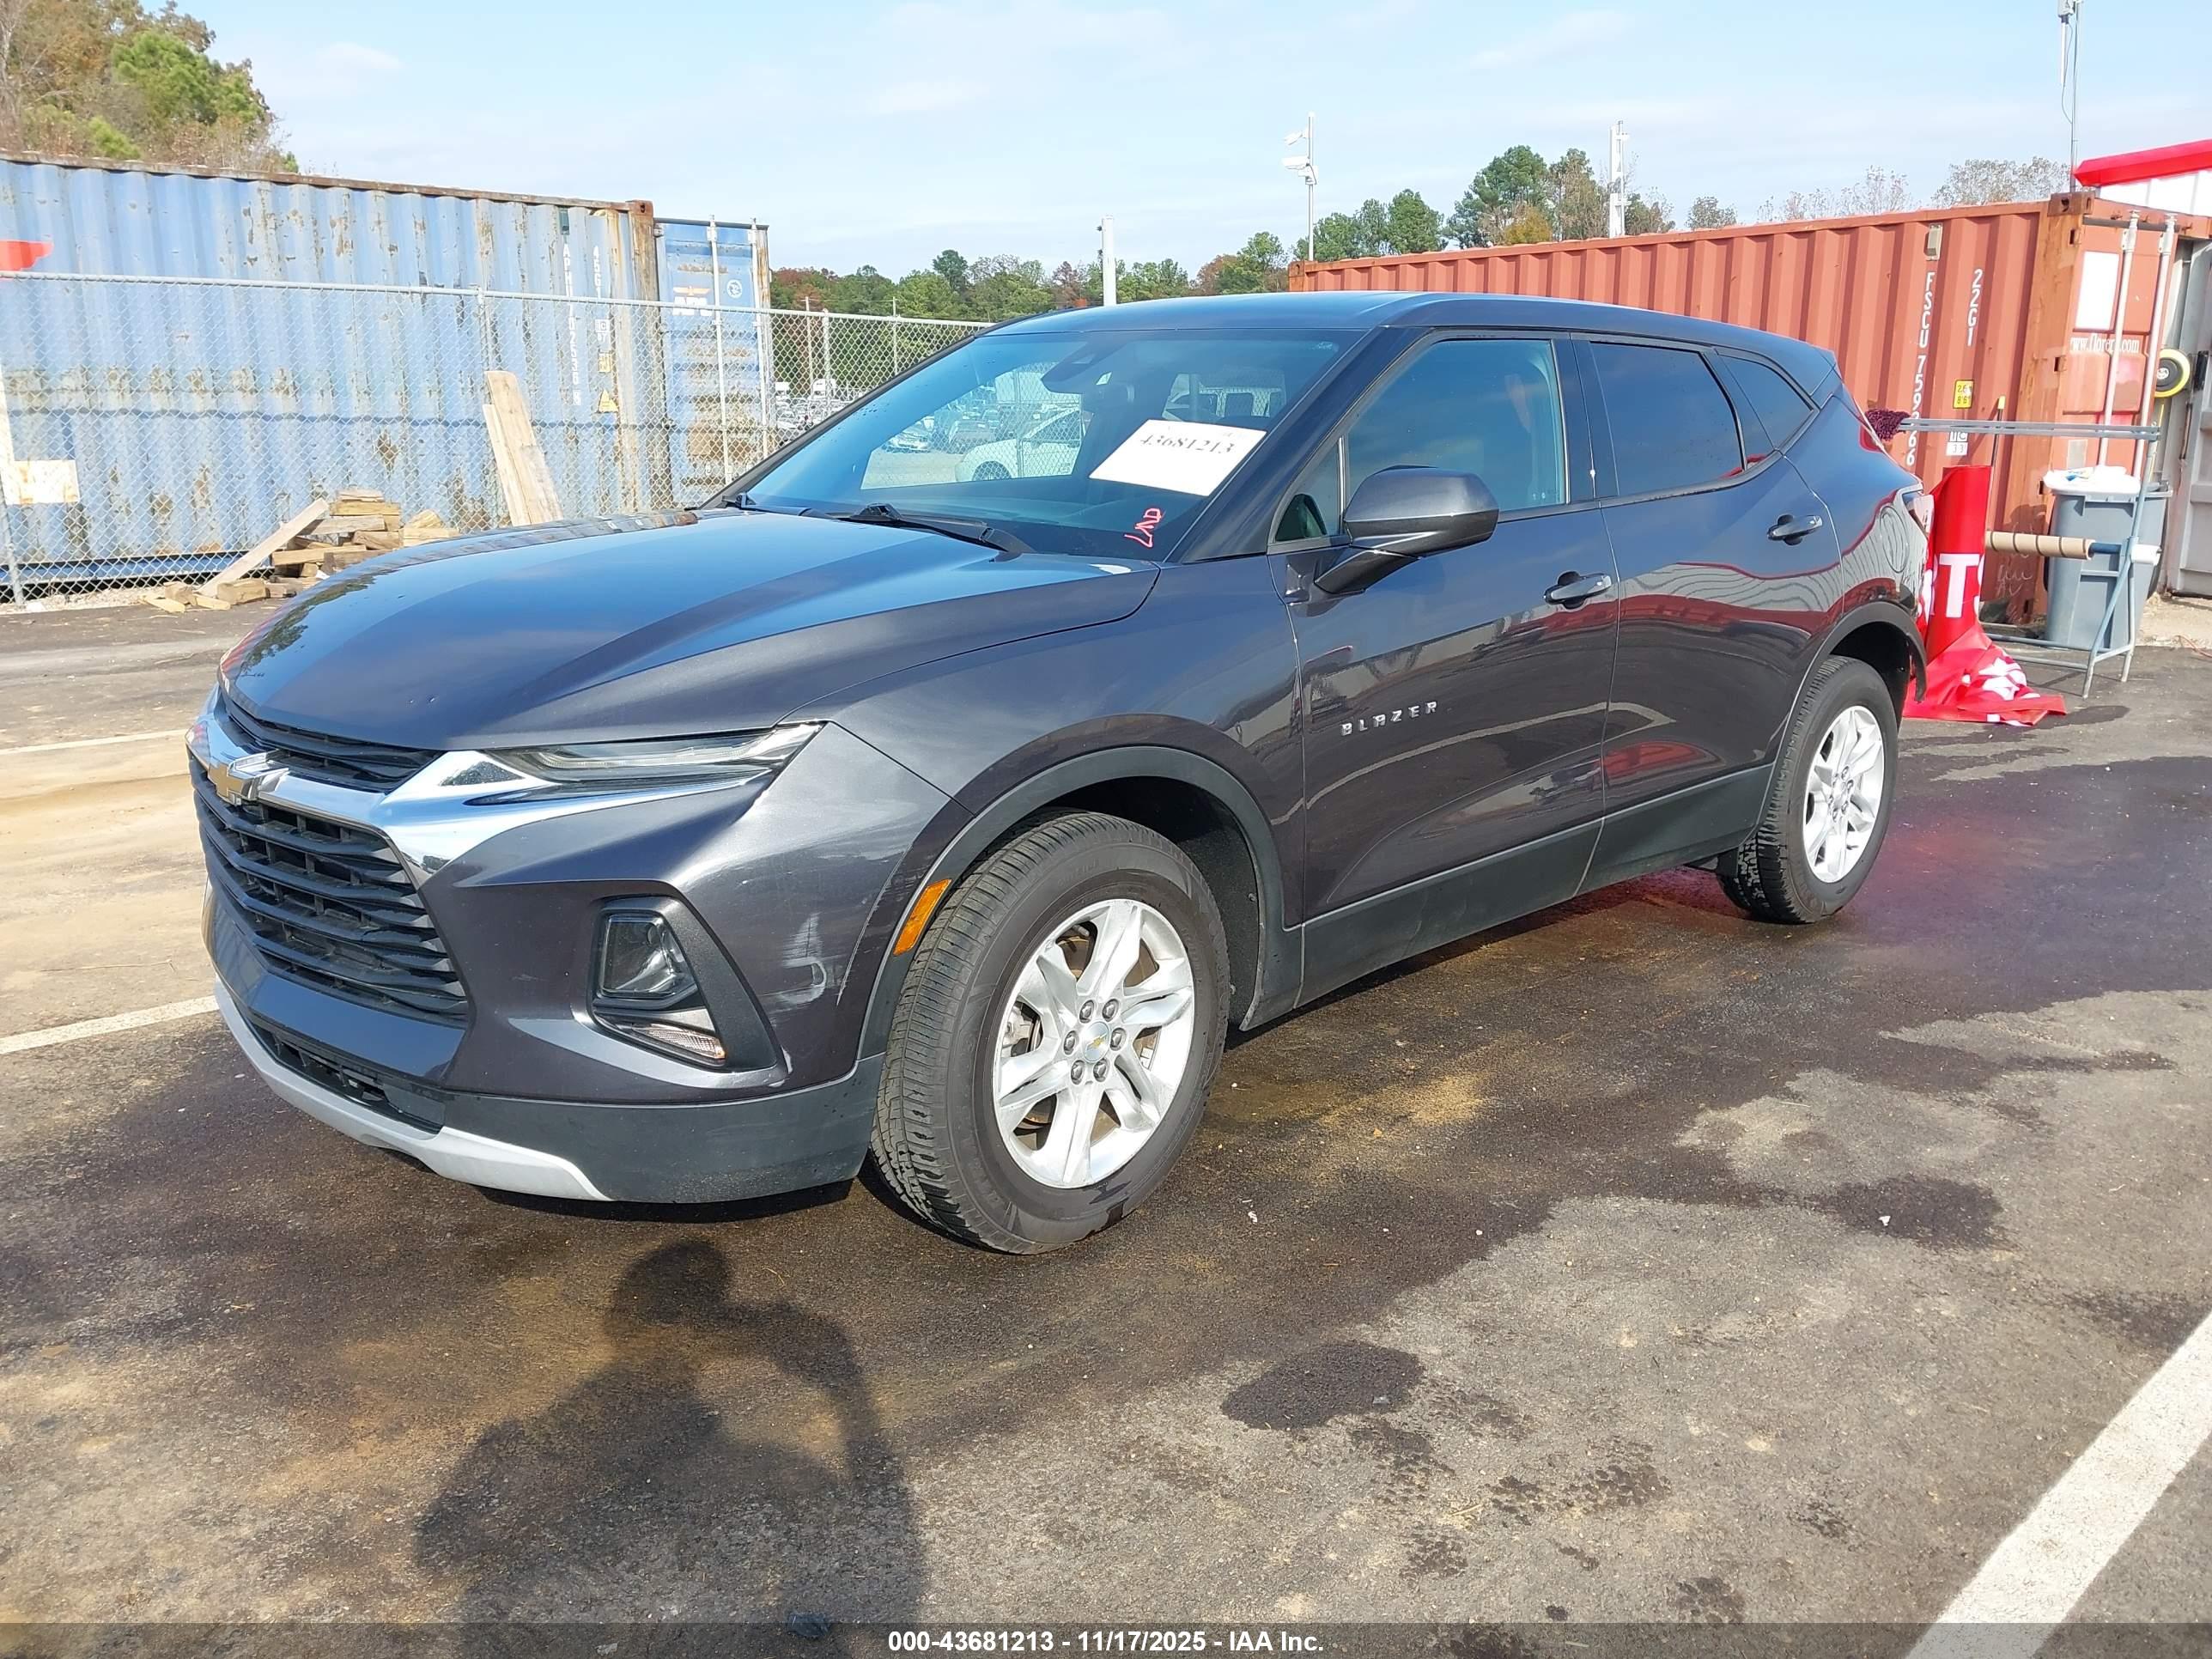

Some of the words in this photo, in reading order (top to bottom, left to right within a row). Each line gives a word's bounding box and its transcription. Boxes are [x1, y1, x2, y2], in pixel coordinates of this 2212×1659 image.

[592, 246, 601, 299] 45G1
[1919, 271, 1936, 348] FSCU
[1966, 268, 1983, 347] 22G1
[1140, 434, 1235, 454] 43681213
[1341, 701, 1437, 735] BLAZER
